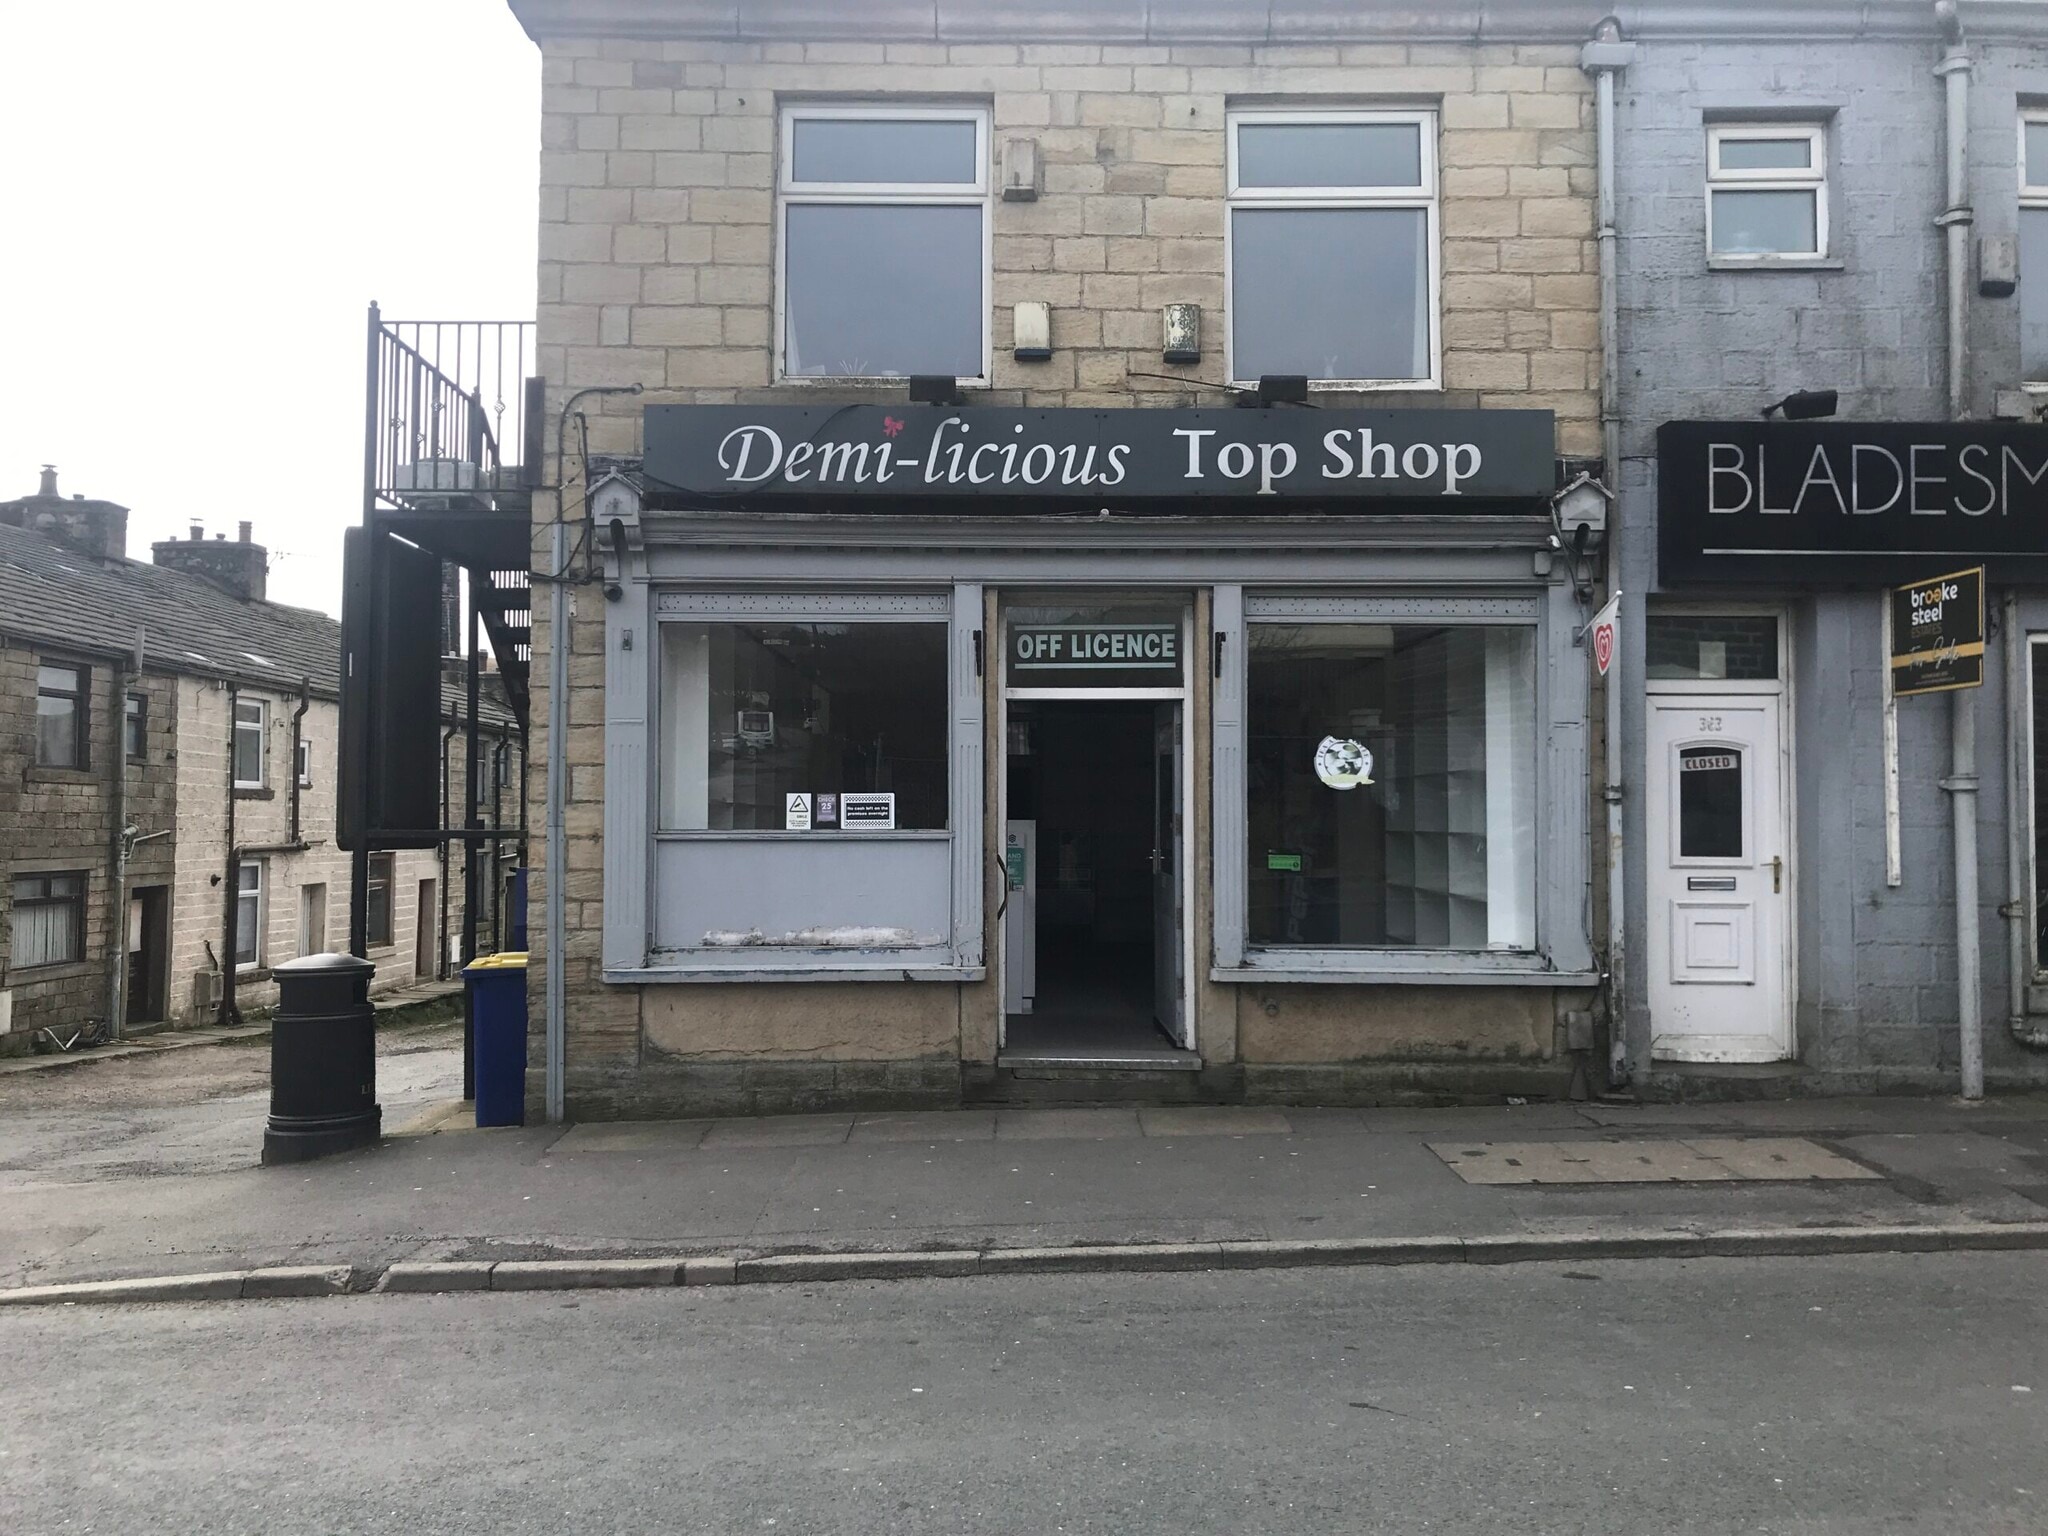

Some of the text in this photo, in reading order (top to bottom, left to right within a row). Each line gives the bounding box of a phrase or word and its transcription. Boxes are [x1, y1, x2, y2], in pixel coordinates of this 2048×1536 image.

[718, 417, 1483, 496] Demi-licious Top Shop
[1707, 444, 2048, 517] BLADESM
[1911, 601, 1943, 626] steel
[1017, 633, 1176, 660] OFF LICENCE
[1685, 757, 1731, 769] CLOSED
[821, 802, 832, 810] 25
